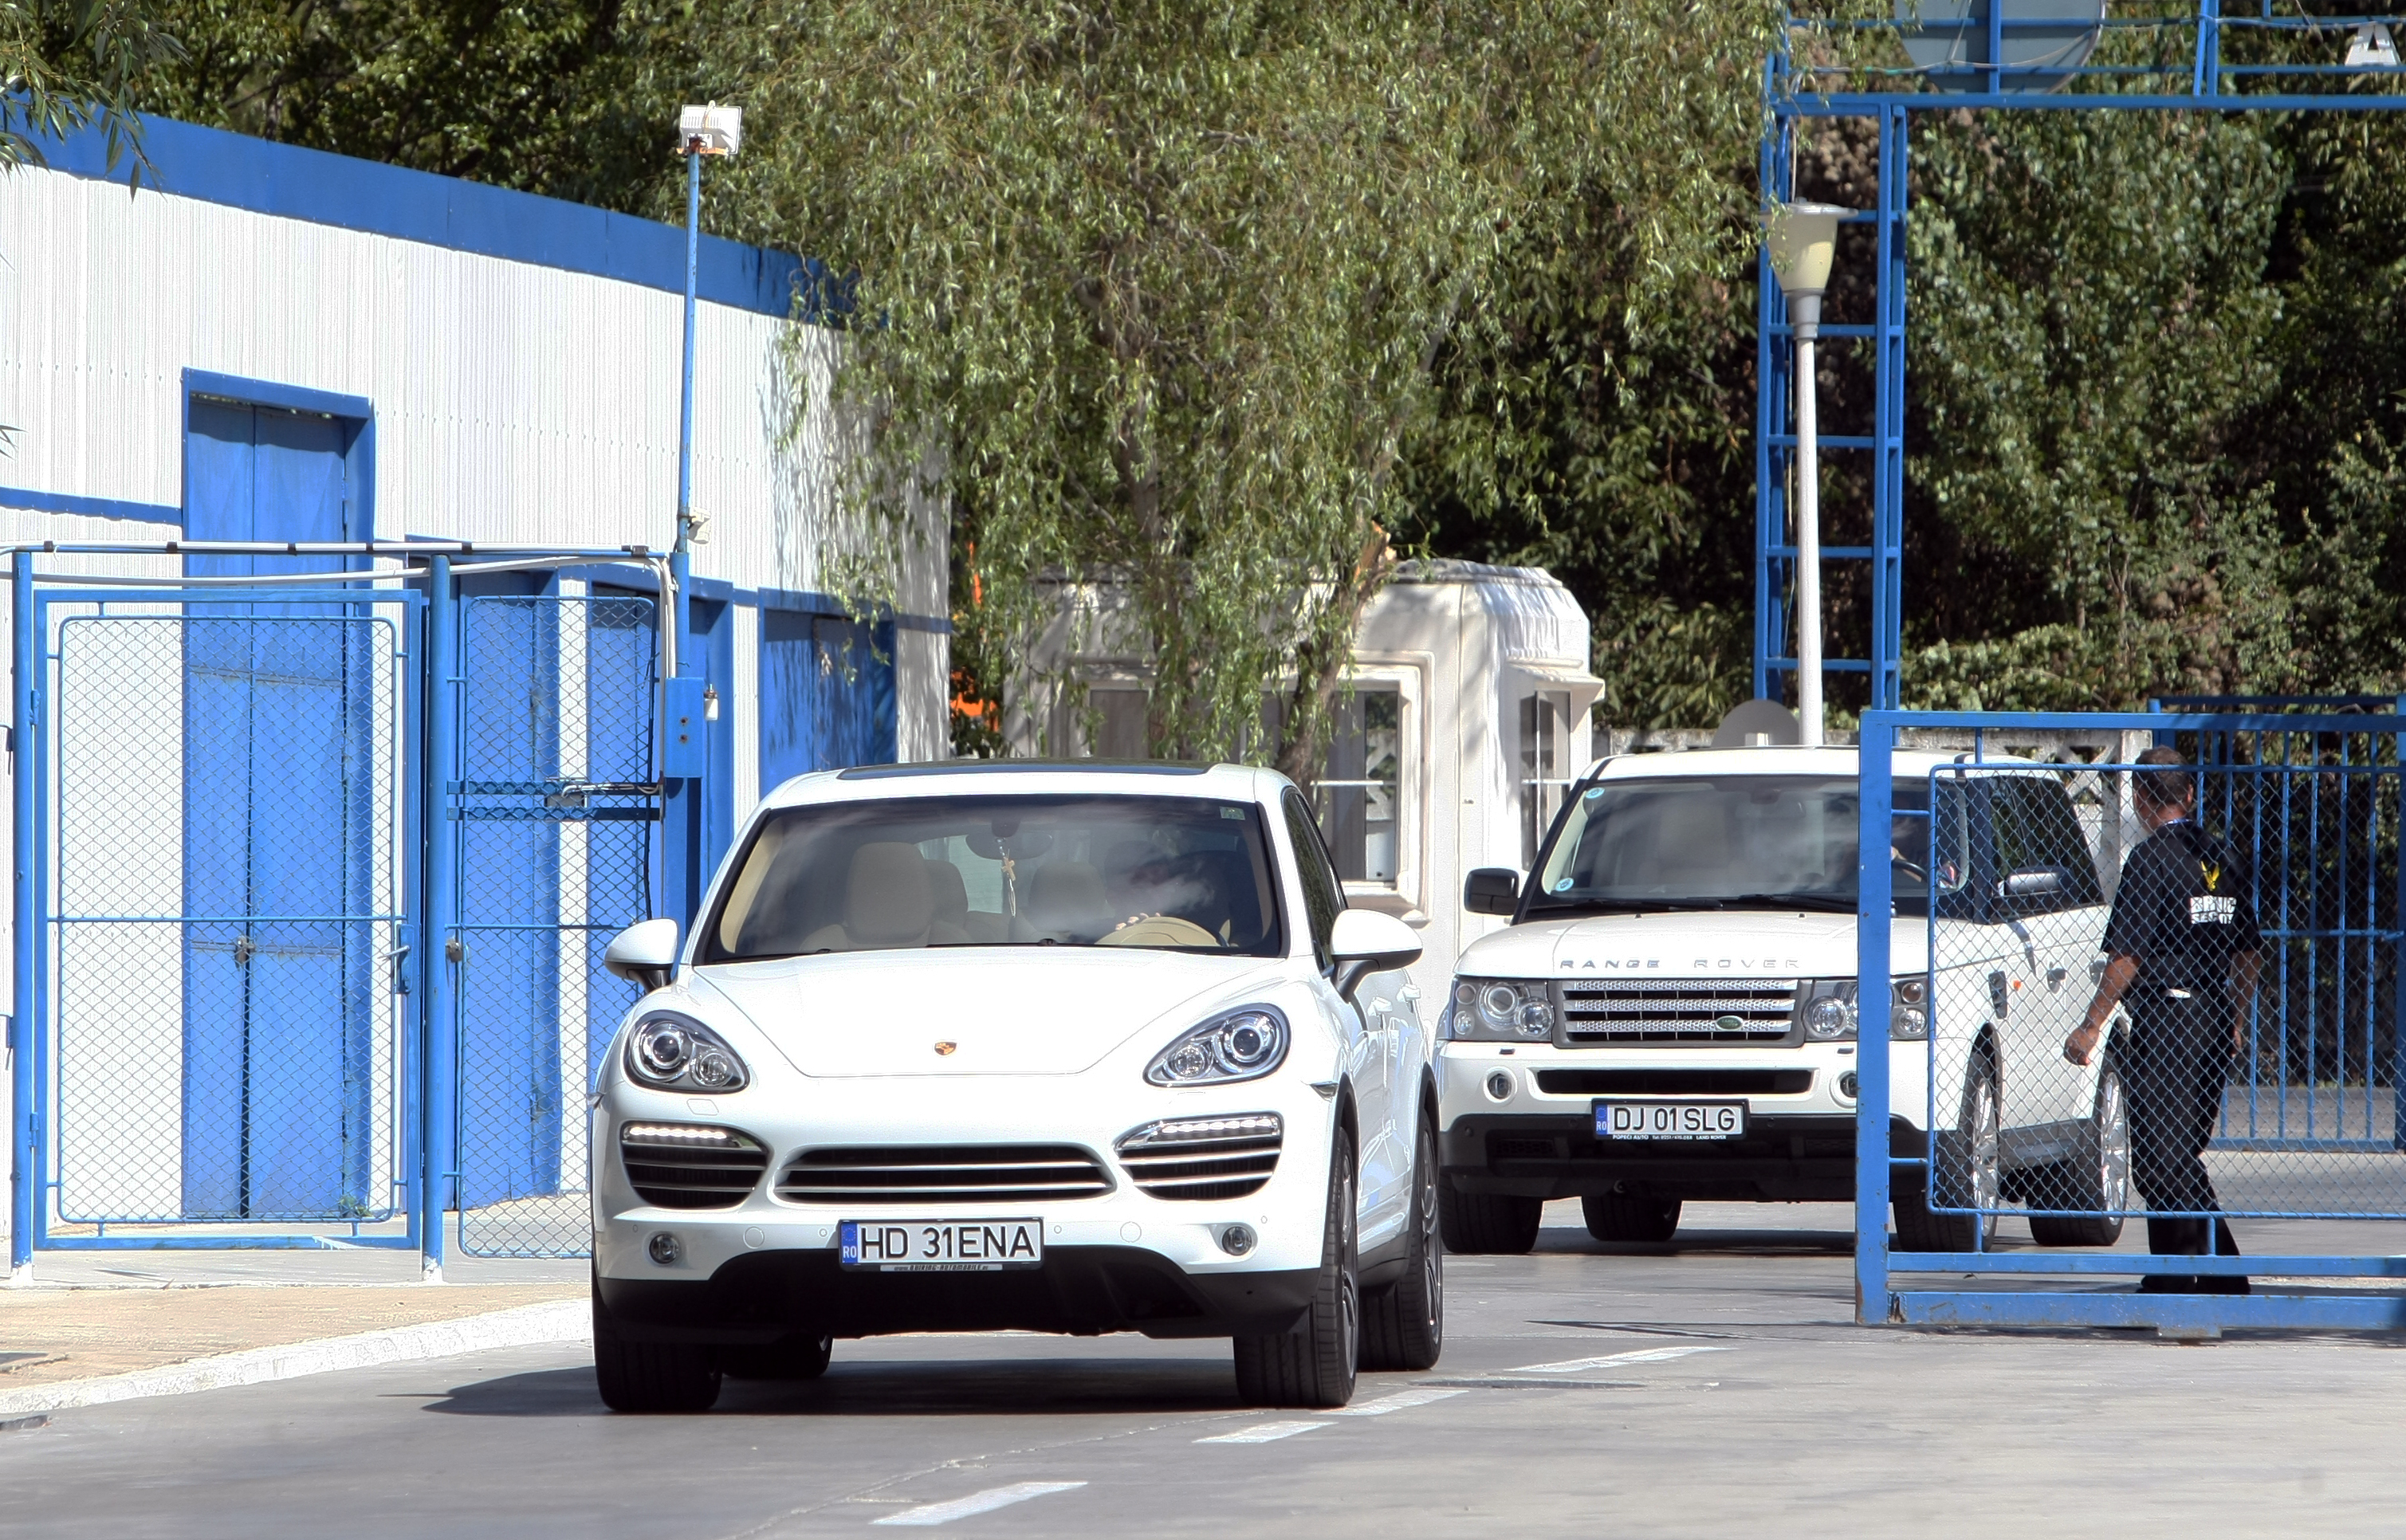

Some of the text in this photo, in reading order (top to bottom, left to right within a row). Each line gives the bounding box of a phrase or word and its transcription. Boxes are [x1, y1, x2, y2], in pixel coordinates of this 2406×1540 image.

[1560, 959, 1799, 969] RANGE ROVER
[1596, 1121, 1607, 1131] RO
[1614, 1108, 1644, 1131] DJ
[861, 1227, 908, 1259] HD
[843, 1246, 857, 1259] RO
